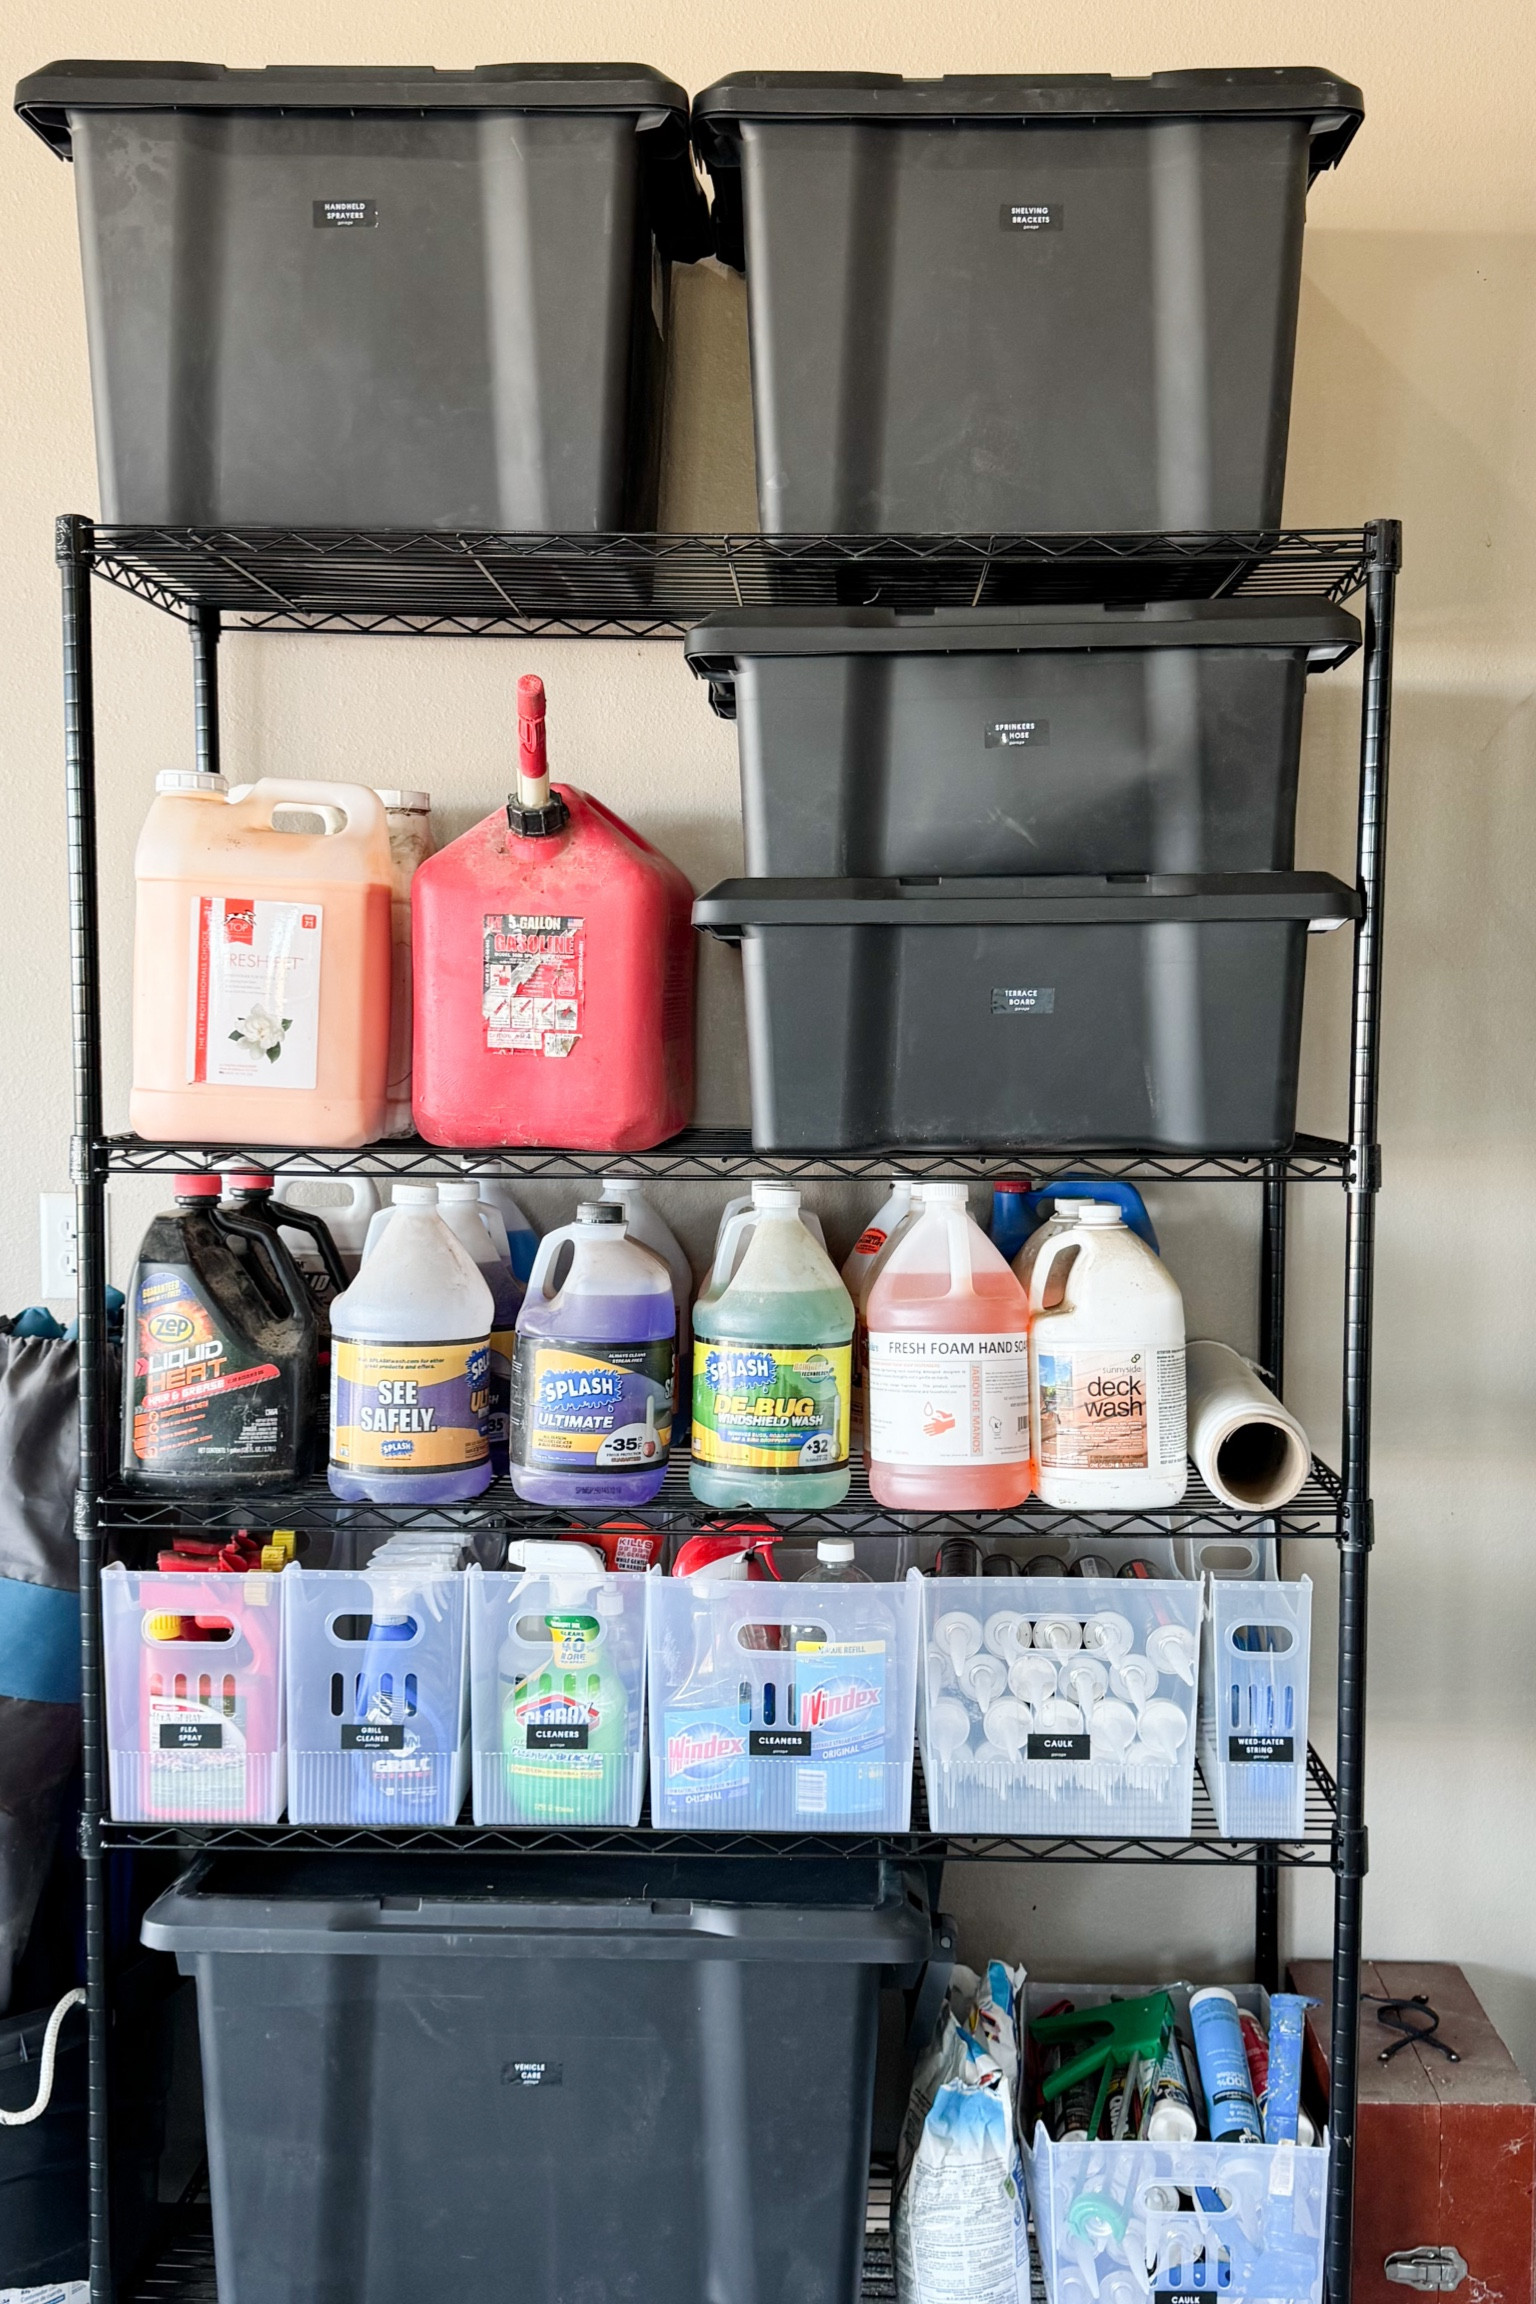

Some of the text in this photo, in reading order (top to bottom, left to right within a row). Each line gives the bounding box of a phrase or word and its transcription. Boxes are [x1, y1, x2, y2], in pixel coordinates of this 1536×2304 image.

[324, 203, 366, 211] HANDHELD
[1011, 207, 1049, 215] SHELVING
[1012, 216, 1050, 224] BRACKETS
[1009, 731, 1030, 739] HOSE
[229, 922, 249, 931] TOP
[519, 916, 561, 930] GALLON
[494, 933, 575, 954] GASOLINE
[229, 953, 268, 968] RESH
[1005, 989, 1038, 997] TERRACE
[1009, 998, 1036, 1006] BOARD
[889, 1341, 926, 1354] FRESH
[930, 1342, 974, 1355] FOAM
[978, 1341, 1013, 1354] HAND
[149, 1340, 224, 1373] LIQUID
[148, 1357, 227, 1393] HEAT
[710, 1359, 769, 1382] SPLASH
[1102, 1365, 1142, 1375] sunnyside
[147, 1393, 170, 1406] HAIR
[182, 1379, 225, 1398] GREASE
[377, 1379, 419, 1405] SEE
[545, 1377, 613, 1402] SPLASH
[1087, 1375, 1143, 1397] deck
[713, 1394, 815, 1419] DE-BUG
[972, 1365, 981, 1453] JABON DE MANOS
[1084, 1396, 1143, 1417] wash
[360, 1406, 437, 1433] SAFELY.
[538, 1413, 614, 1429] ULTIMATE
[717, 1412, 824, 1427] WINDSHIELD WASH
[382, 1442, 412, 1454] SPLASH
[605, 1437, 638, 1452] -35
[806, 1439, 828, 1454] +32
[618, 1537, 653, 1550] KILLS
[843, 1645, 866, 1654] REFILL
[801, 1686, 880, 1732] Windex
[535, 1730, 580, 1739] CLEANERS
[758, 1736, 803, 1745] CLEANERS
[1043, 1739, 1073, 1748] CAULK
[1237, 1738, 1285, 1746] WEED-EATER
[669, 1734, 745, 1776] Windex
[822, 1744, 860, 1759] ORIGINAL
[1245, 1746, 1274, 1754] STRING
[685, 1790, 722, 1804] ORIGINAL
[514, 2063, 546, 2071] VEHICLE
[520, 2071, 542, 2079] CARE
[1216, 2077, 1248, 2088] 100%
[1171, 2295, 1201, 2304] CAULK
